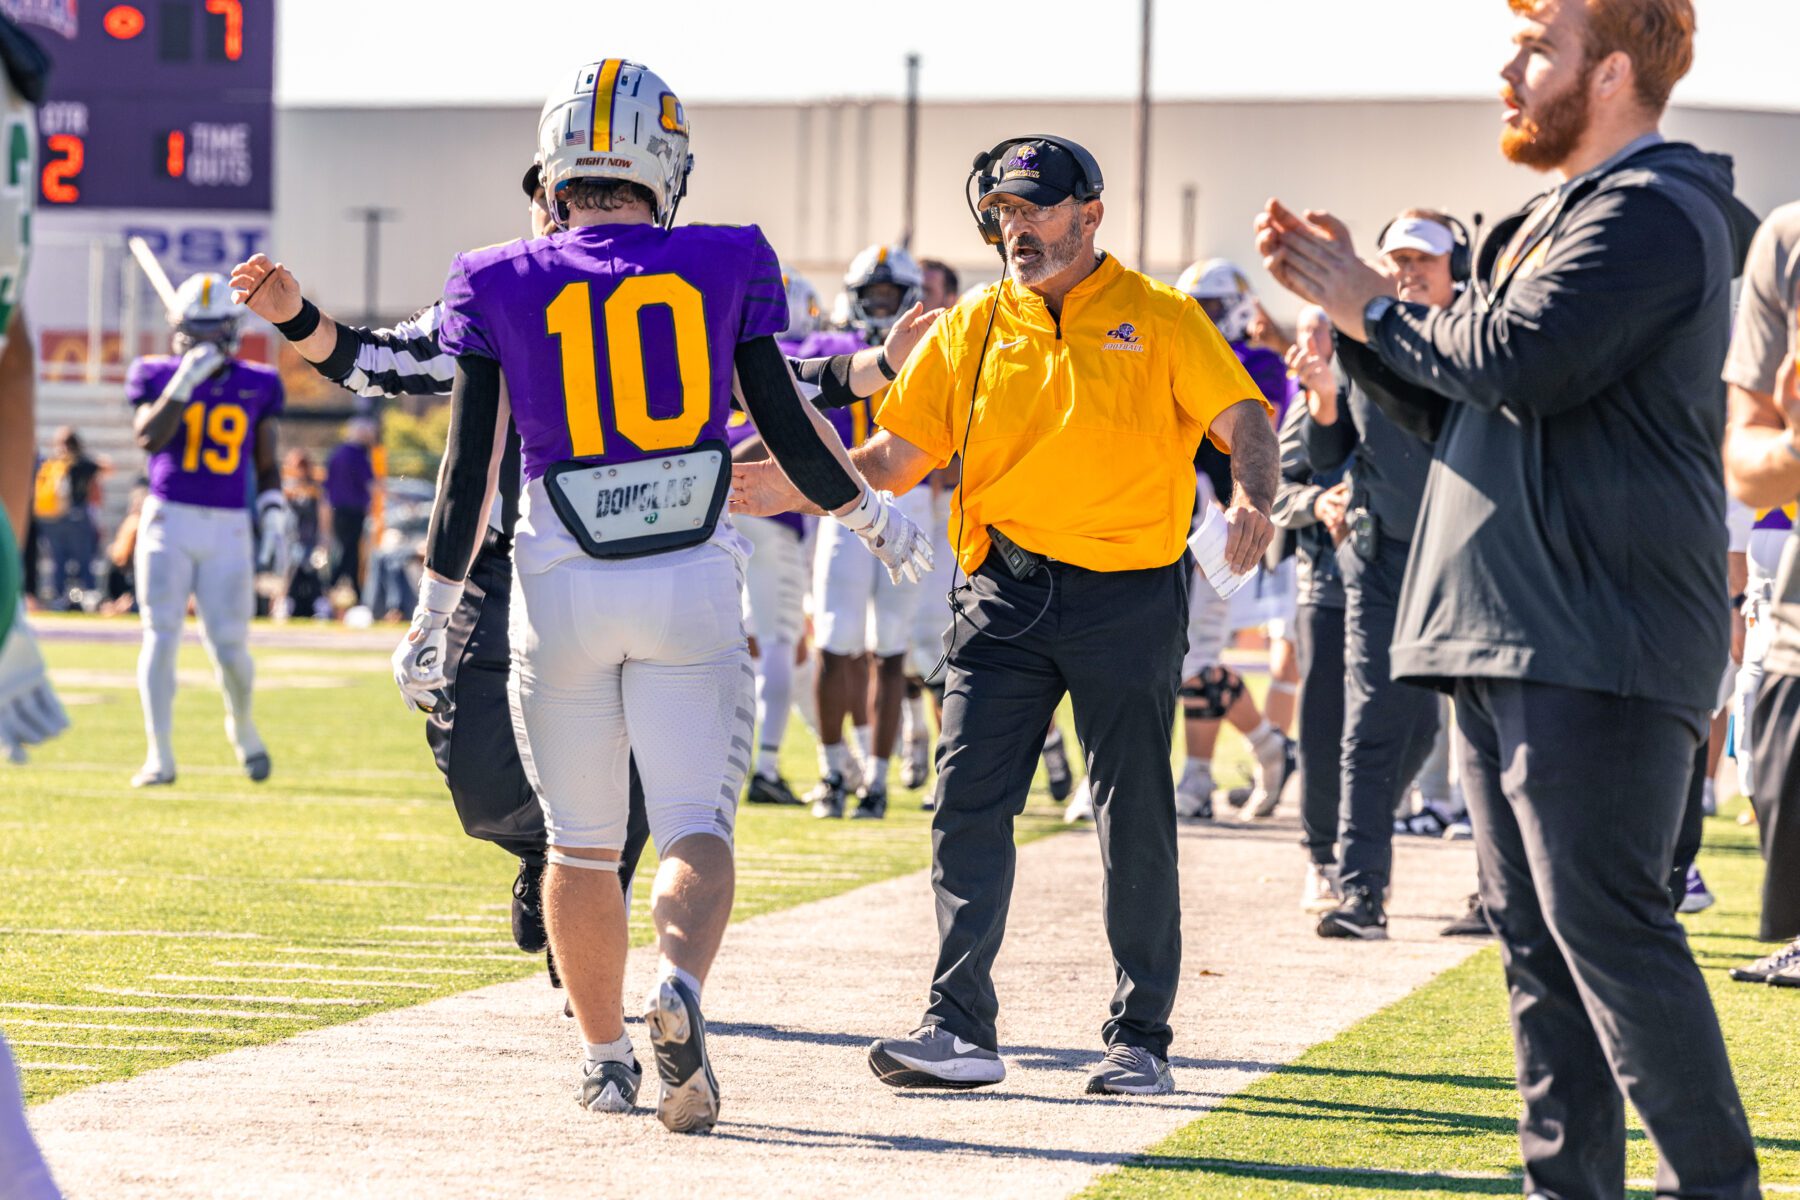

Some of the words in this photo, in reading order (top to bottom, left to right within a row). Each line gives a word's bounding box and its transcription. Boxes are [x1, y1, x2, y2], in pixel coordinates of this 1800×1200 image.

[167, 129, 185, 178] 1
[191, 123, 250, 152] TIME
[42, 134, 84, 203] 2
[187, 152, 251, 186] OUTS
[575, 157, 606, 166] RIGHT
[608, 158, 632, 168] NOW
[543, 272, 711, 458] 10
[182, 401, 249, 474] 19
[596, 478, 693, 518] DOUGLAS
